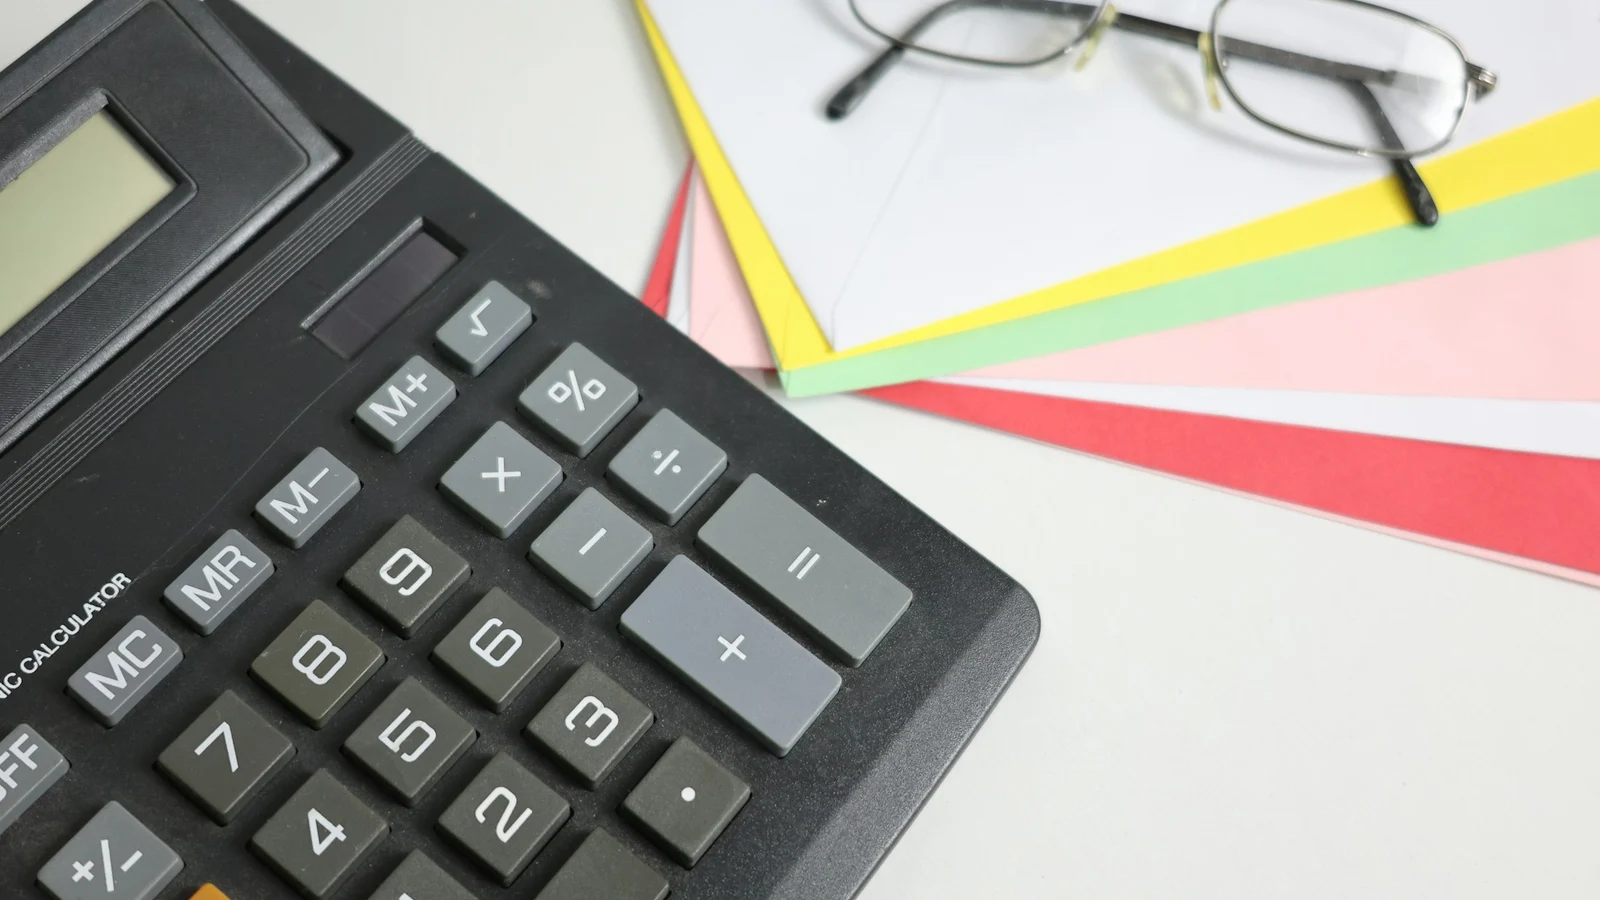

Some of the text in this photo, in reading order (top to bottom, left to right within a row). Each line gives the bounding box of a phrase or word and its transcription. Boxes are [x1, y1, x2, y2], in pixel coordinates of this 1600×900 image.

[368, 373, 428, 427] M+
[548, 370, 606, 411] %
[180, 545, 257, 612] MR
[379, 548, 432, 595] 9
[787, 546, 821, 580] =
[19, 572, 132, 675] CALCULATOR
[470, 618, 522, 667] 6
[718, 635, 746, 662] +
[84, 629, 163, 700] MC
[292, 634, 347, 685] 8
[194, 721, 239, 773] 7
[378, 708, 436, 763] 5
[565, 696, 618, 747] 3
[0, 733, 39, 801] FF
[307, 807, 347, 856] 4
[475, 786, 532, 843] 2
[72, 839, 143, 892] +/-
